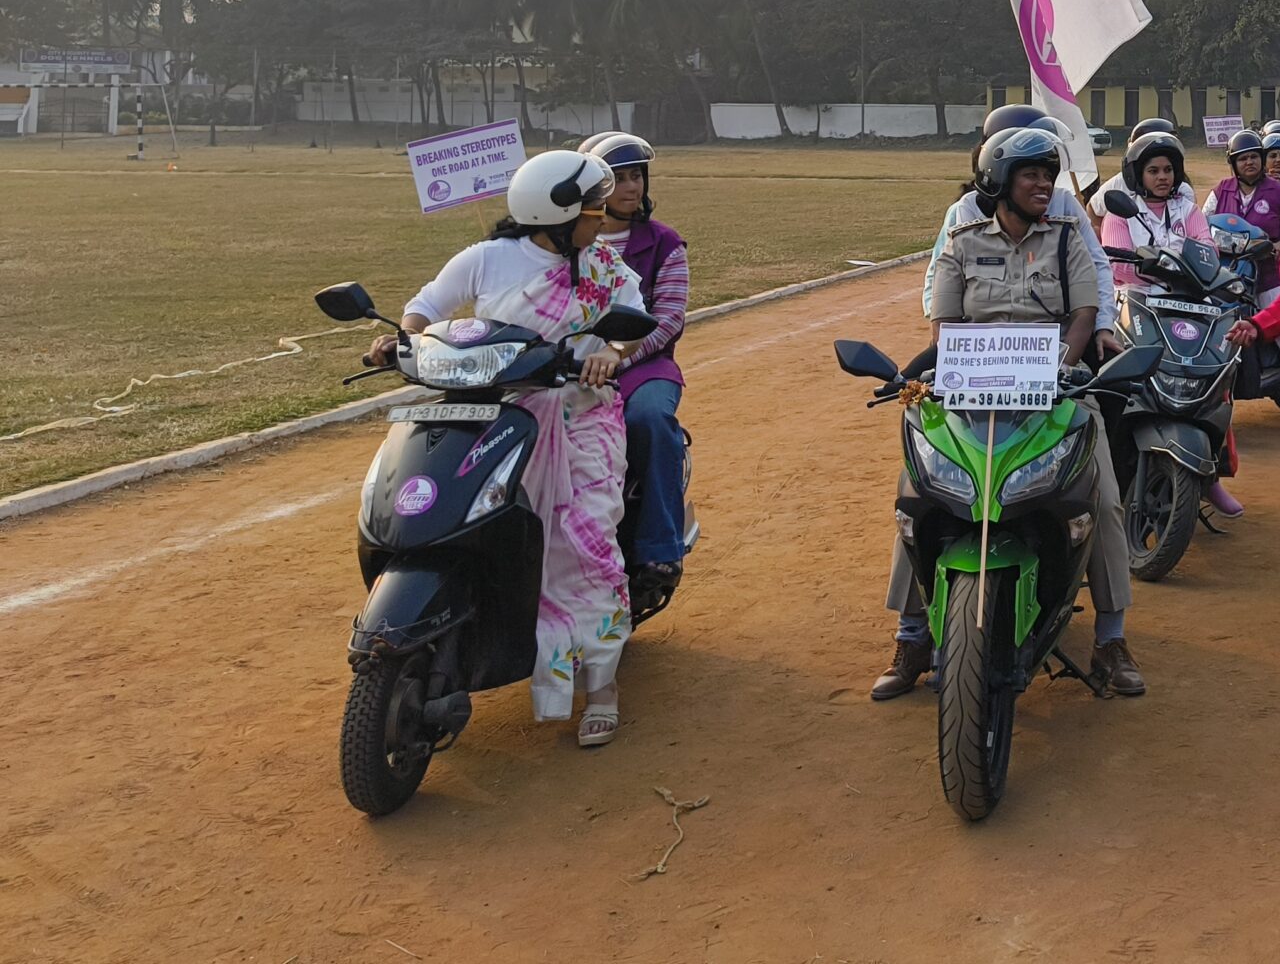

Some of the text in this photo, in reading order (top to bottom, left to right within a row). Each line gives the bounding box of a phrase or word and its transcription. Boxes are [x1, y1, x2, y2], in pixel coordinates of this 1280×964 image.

[416, 133, 517, 167] BREAKING STEREOTYPES
[431, 164, 448, 177] ONE
[449, 160, 470, 174] ROAD
[471, 157, 480, 168] AT
[481, 156, 487, 165] A
[946, 336, 1053, 353] LIFE IS A JOURNEY
[943, 356, 1052, 367] AND SHE'S BEHIND THE WHEEL.
[948, 393, 965, 406] AP
[996, 393, 1011, 406] AU
[471, 425, 515, 464] Pleasure
